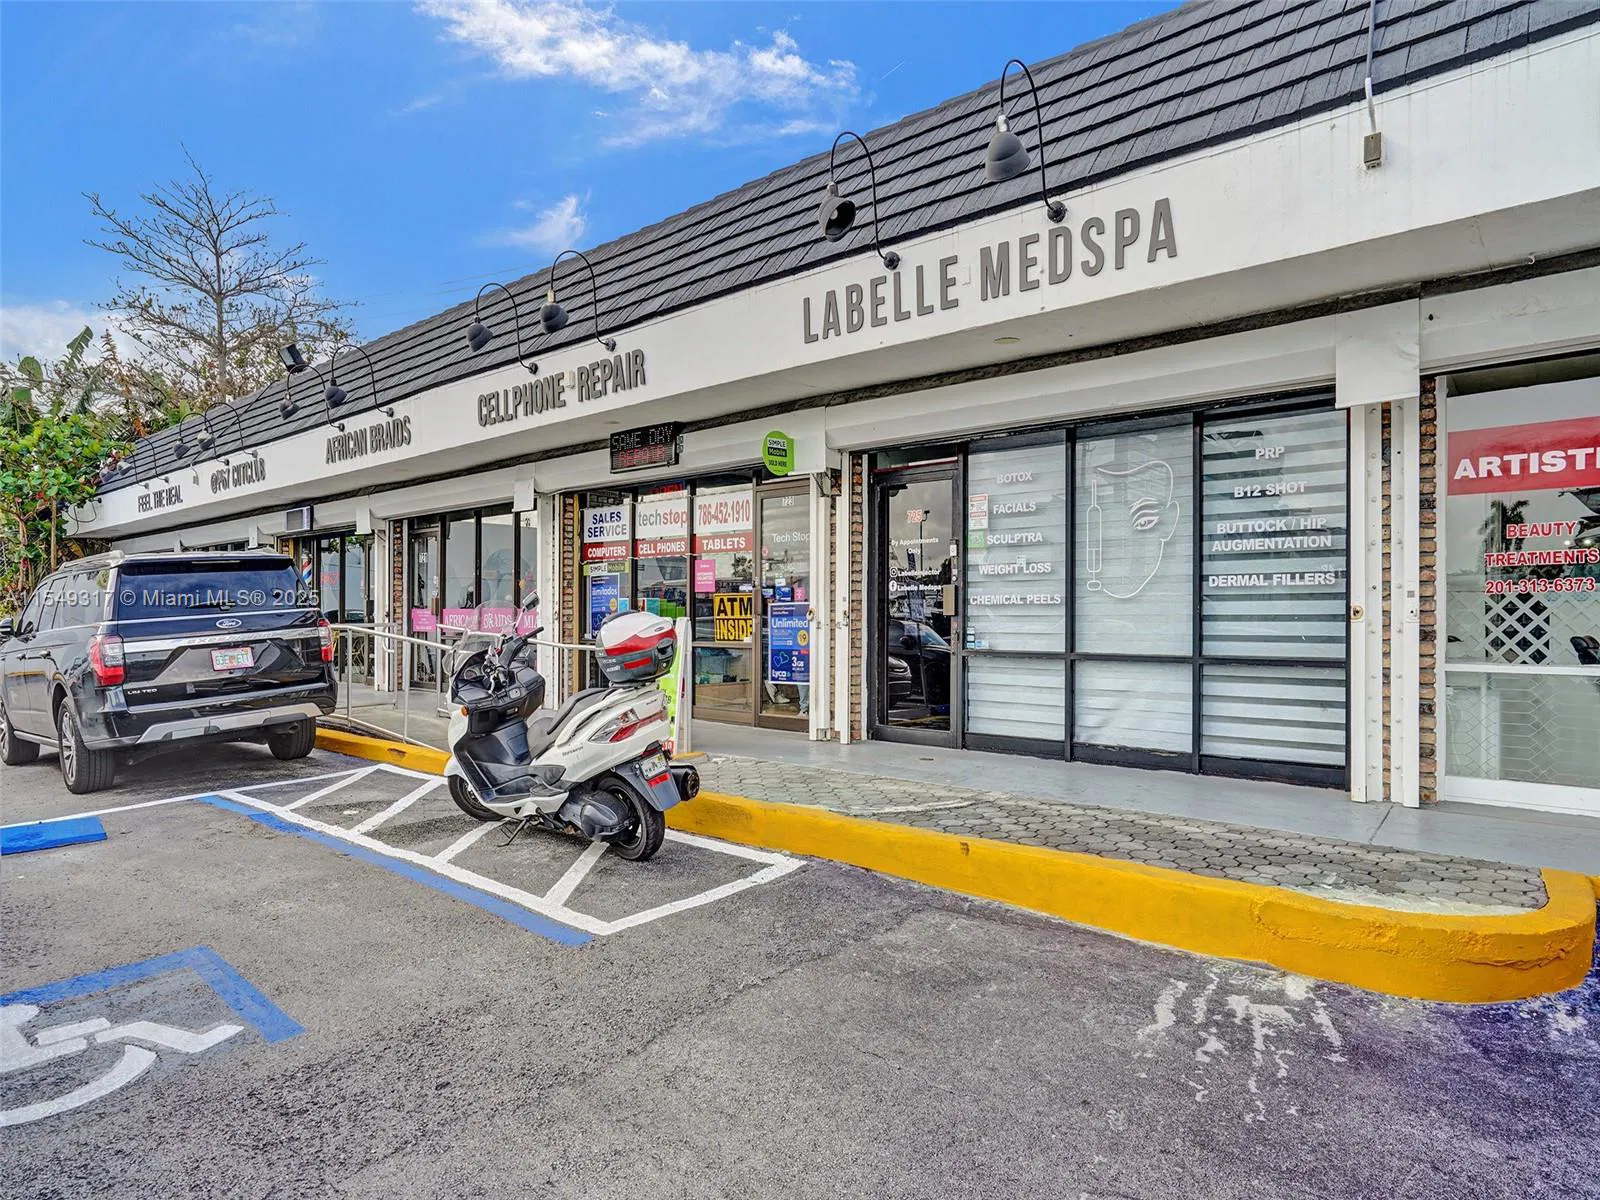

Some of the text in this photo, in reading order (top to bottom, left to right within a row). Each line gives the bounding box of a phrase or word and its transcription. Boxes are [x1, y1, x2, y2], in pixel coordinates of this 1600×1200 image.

[803, 198, 1178, 344] LABELLE MEDSPA
[477, 349, 646, 427] CELLPHONE REPAIR
[325, 416, 411, 464] AFRICAN BRAIDS
[612, 425, 672, 452] SAME DAY
[768, 439, 786, 448] SIMPLE
[619, 445, 665, 466] REPAIR
[768, 448, 787, 457] Mobile
[1255, 446, 1285, 460] PRP
[768, 460, 788, 468] SOLD HERE
[996, 471, 1032, 484] BOTOX
[1234, 481, 1308, 498] B12 SHOT
[138, 494, 152, 512] FEEL
[153, 488, 165, 509] THE
[698, 499, 750, 525] 786-452-1910
[993, 501, 1036, 514] FACIALS
[592, 511, 621, 525] SALES
[907, 509, 923, 523] 725
[588, 524, 627, 538] SERVICE
[1217, 519, 1286, 534] BUTTOCK
[1301, 517, 1327, 529] HIP
[1506, 521, 1577, 539] BEAUTY
[702, 537, 746, 550] TABLETS
[772, 532, 810, 543] Tech Stop
[987, 532, 1043, 544] SCULPTRA
[1212, 536, 1332, 552] AUGMENTATION
[587, 546, 626, 558] COMPUTERS
[639, 541, 686, 554] CELL PHONES
[1484, 549, 1600, 567] TREATMENTS
[590, 564, 607, 573] SIMPLE
[979, 563, 1051, 575] WEIGHT LOSS
[1209, 573, 1336, 587] DERMAL FILLERS
[1485, 577, 1596, 594] 201-313-6373
[970, 594, 1061, 605] CHEMICAL PEELS
[717, 598, 752, 616] ATM
[483, 613, 513, 629] BRAIDS
[771, 618, 808, 628] Unlimited
[772, 670, 787, 678] Lyca
